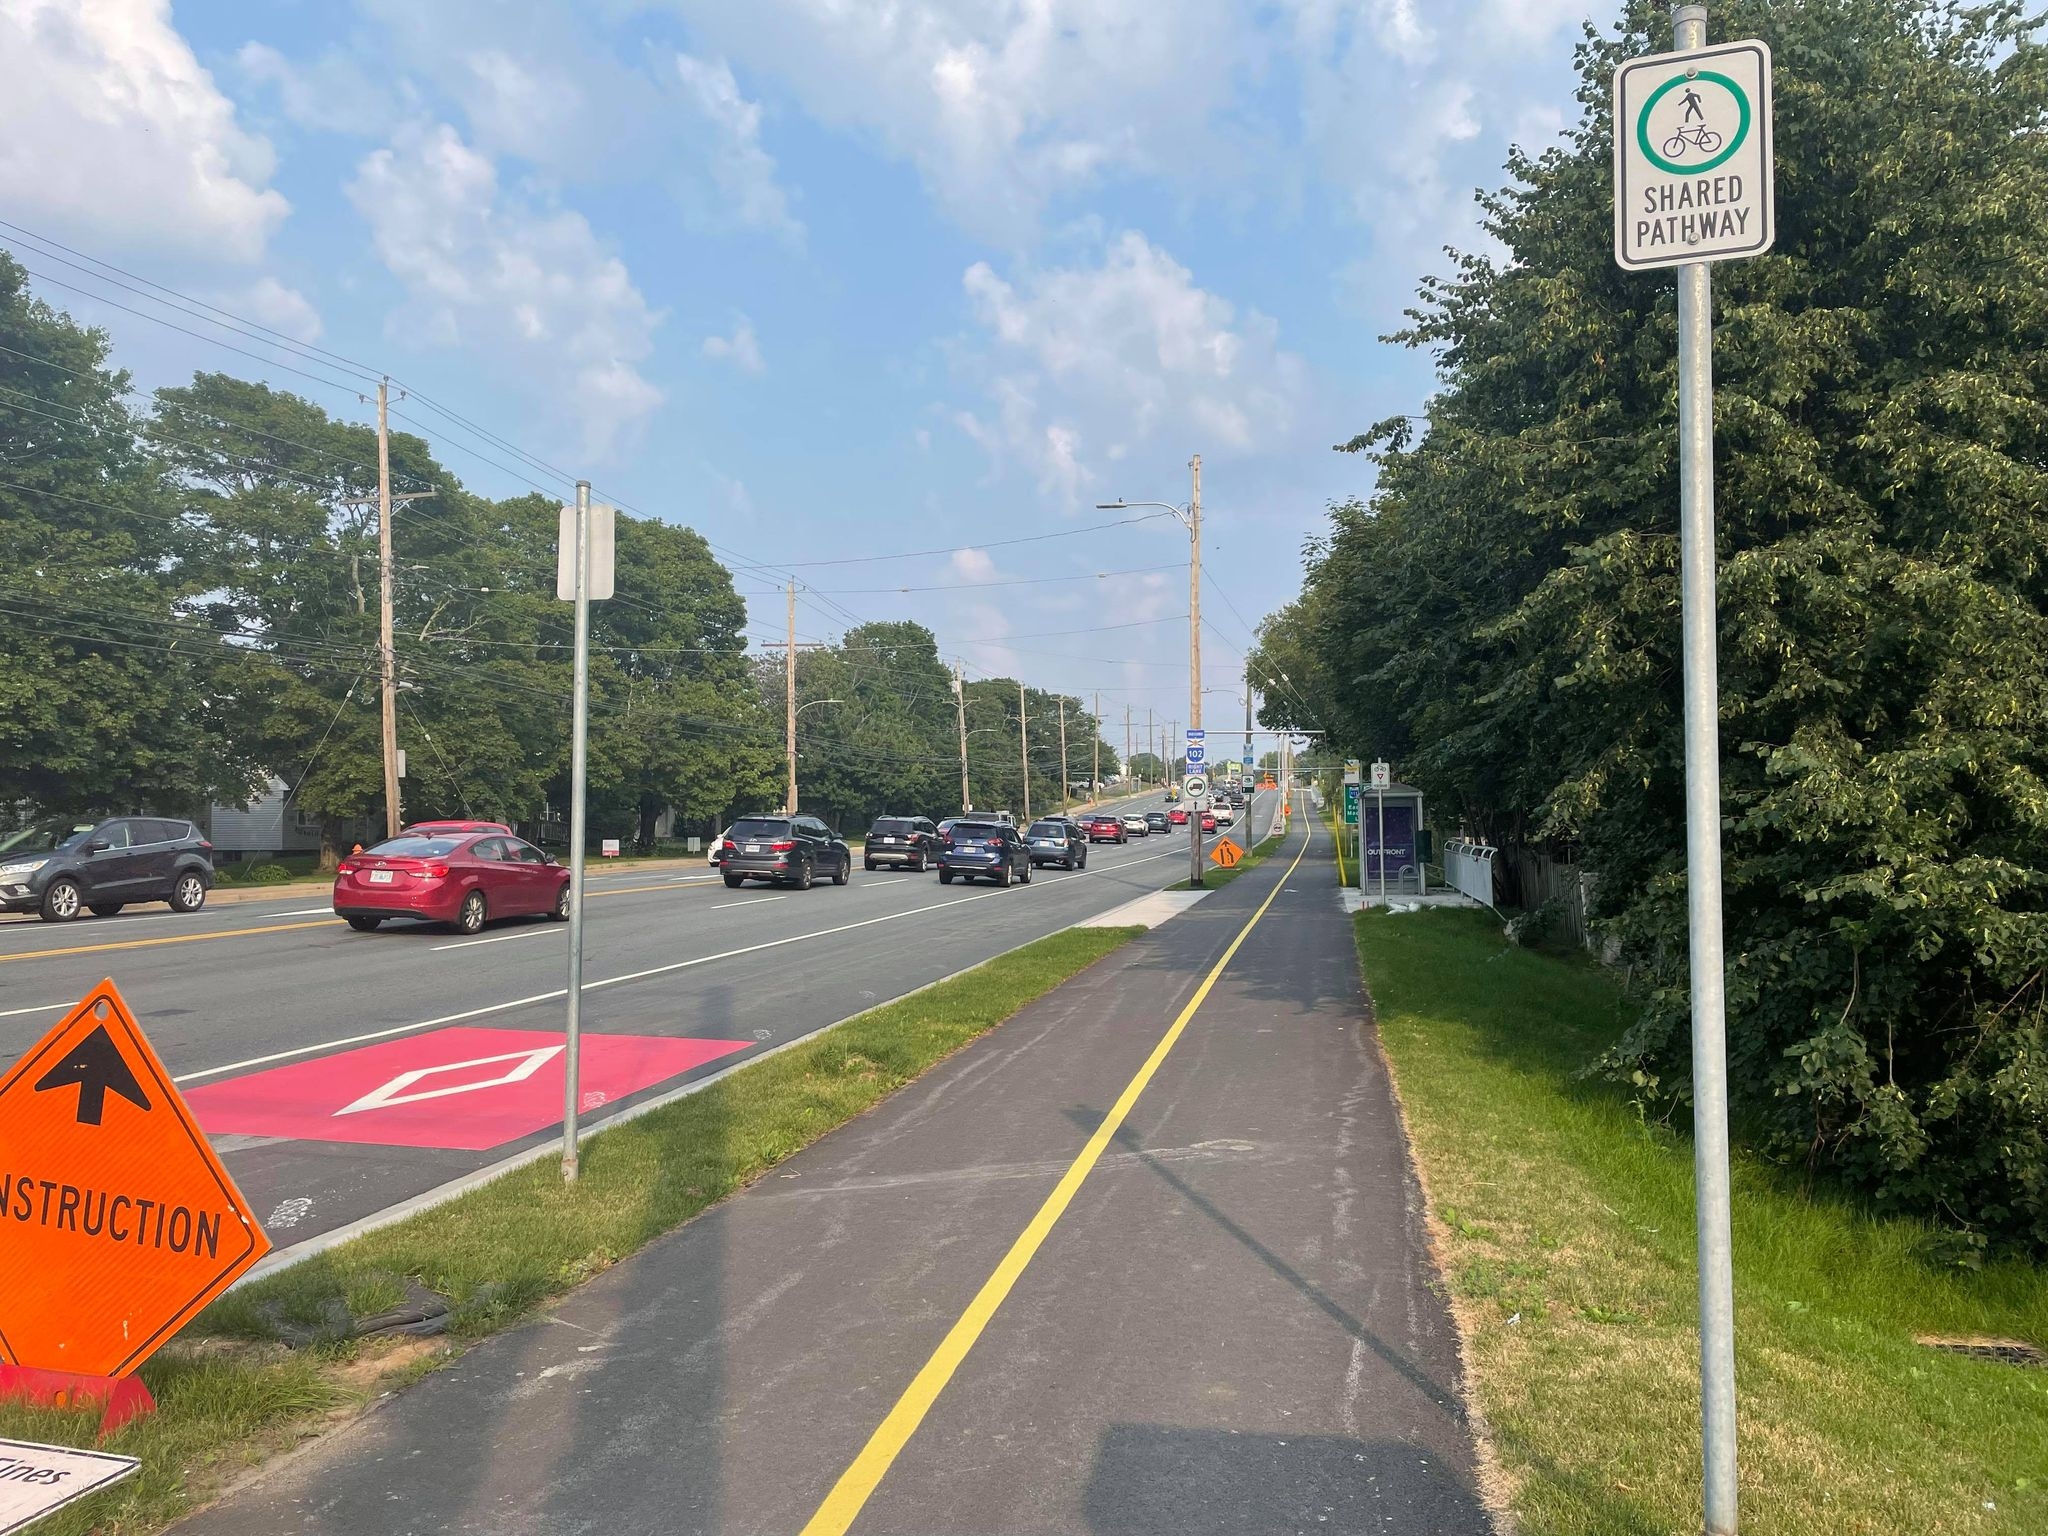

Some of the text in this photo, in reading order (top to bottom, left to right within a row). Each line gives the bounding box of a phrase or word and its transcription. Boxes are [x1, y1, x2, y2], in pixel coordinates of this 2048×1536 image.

[1644, 175, 1743, 213] SHARED
[1637, 207, 1751, 247] PATHWAY
[1189, 750, 1202, 758] 102
